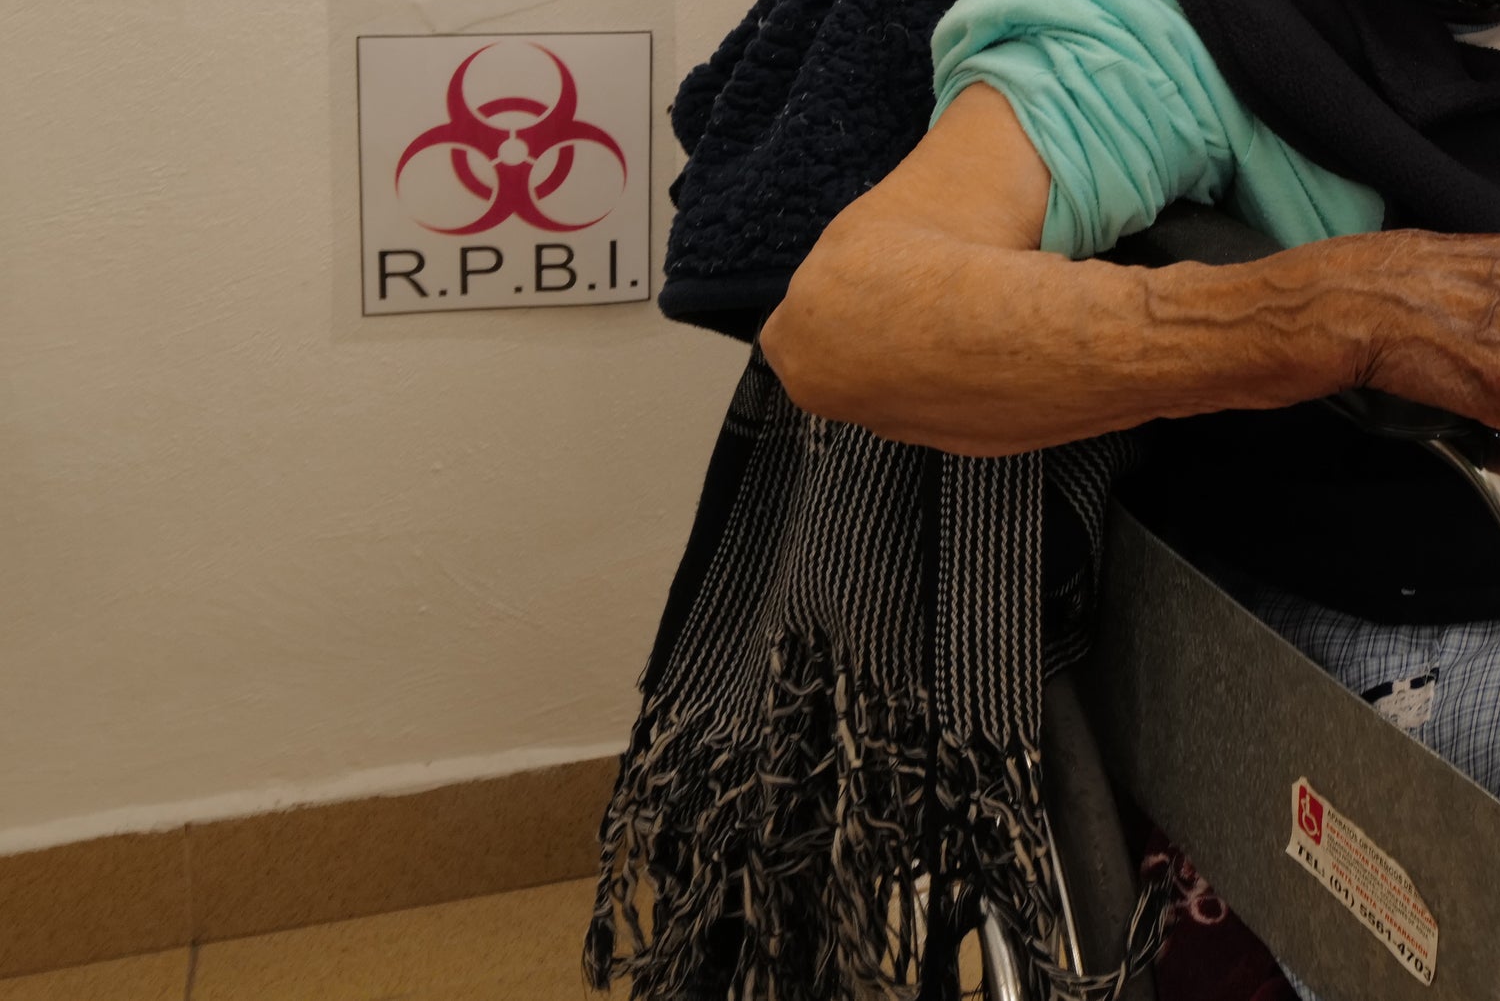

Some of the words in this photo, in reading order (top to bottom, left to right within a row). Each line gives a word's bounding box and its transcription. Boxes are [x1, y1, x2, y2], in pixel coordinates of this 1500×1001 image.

[378, 240, 638, 300] R.P.B.I.
[1329, 874, 1355, 909] (01)
[1359, 902, 1432, 982] 5561-4703
